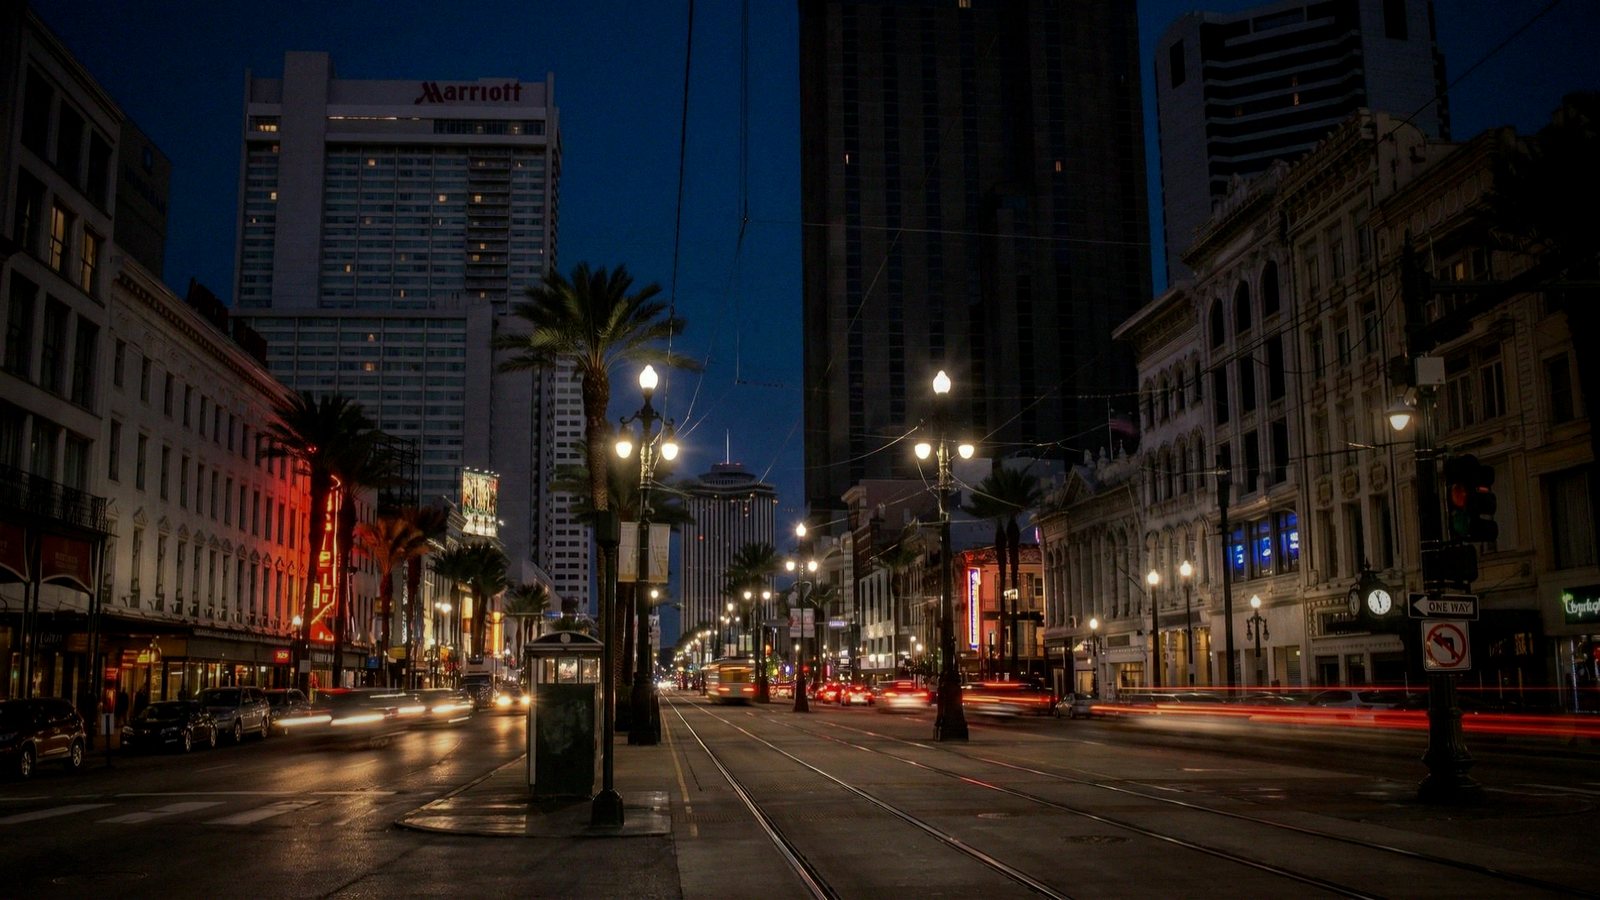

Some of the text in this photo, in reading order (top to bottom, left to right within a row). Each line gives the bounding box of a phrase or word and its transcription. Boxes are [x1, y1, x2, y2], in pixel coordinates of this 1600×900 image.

[414, 80, 522, 104] Marriott
[1429, 602, 1470, 613] ONE WAY
